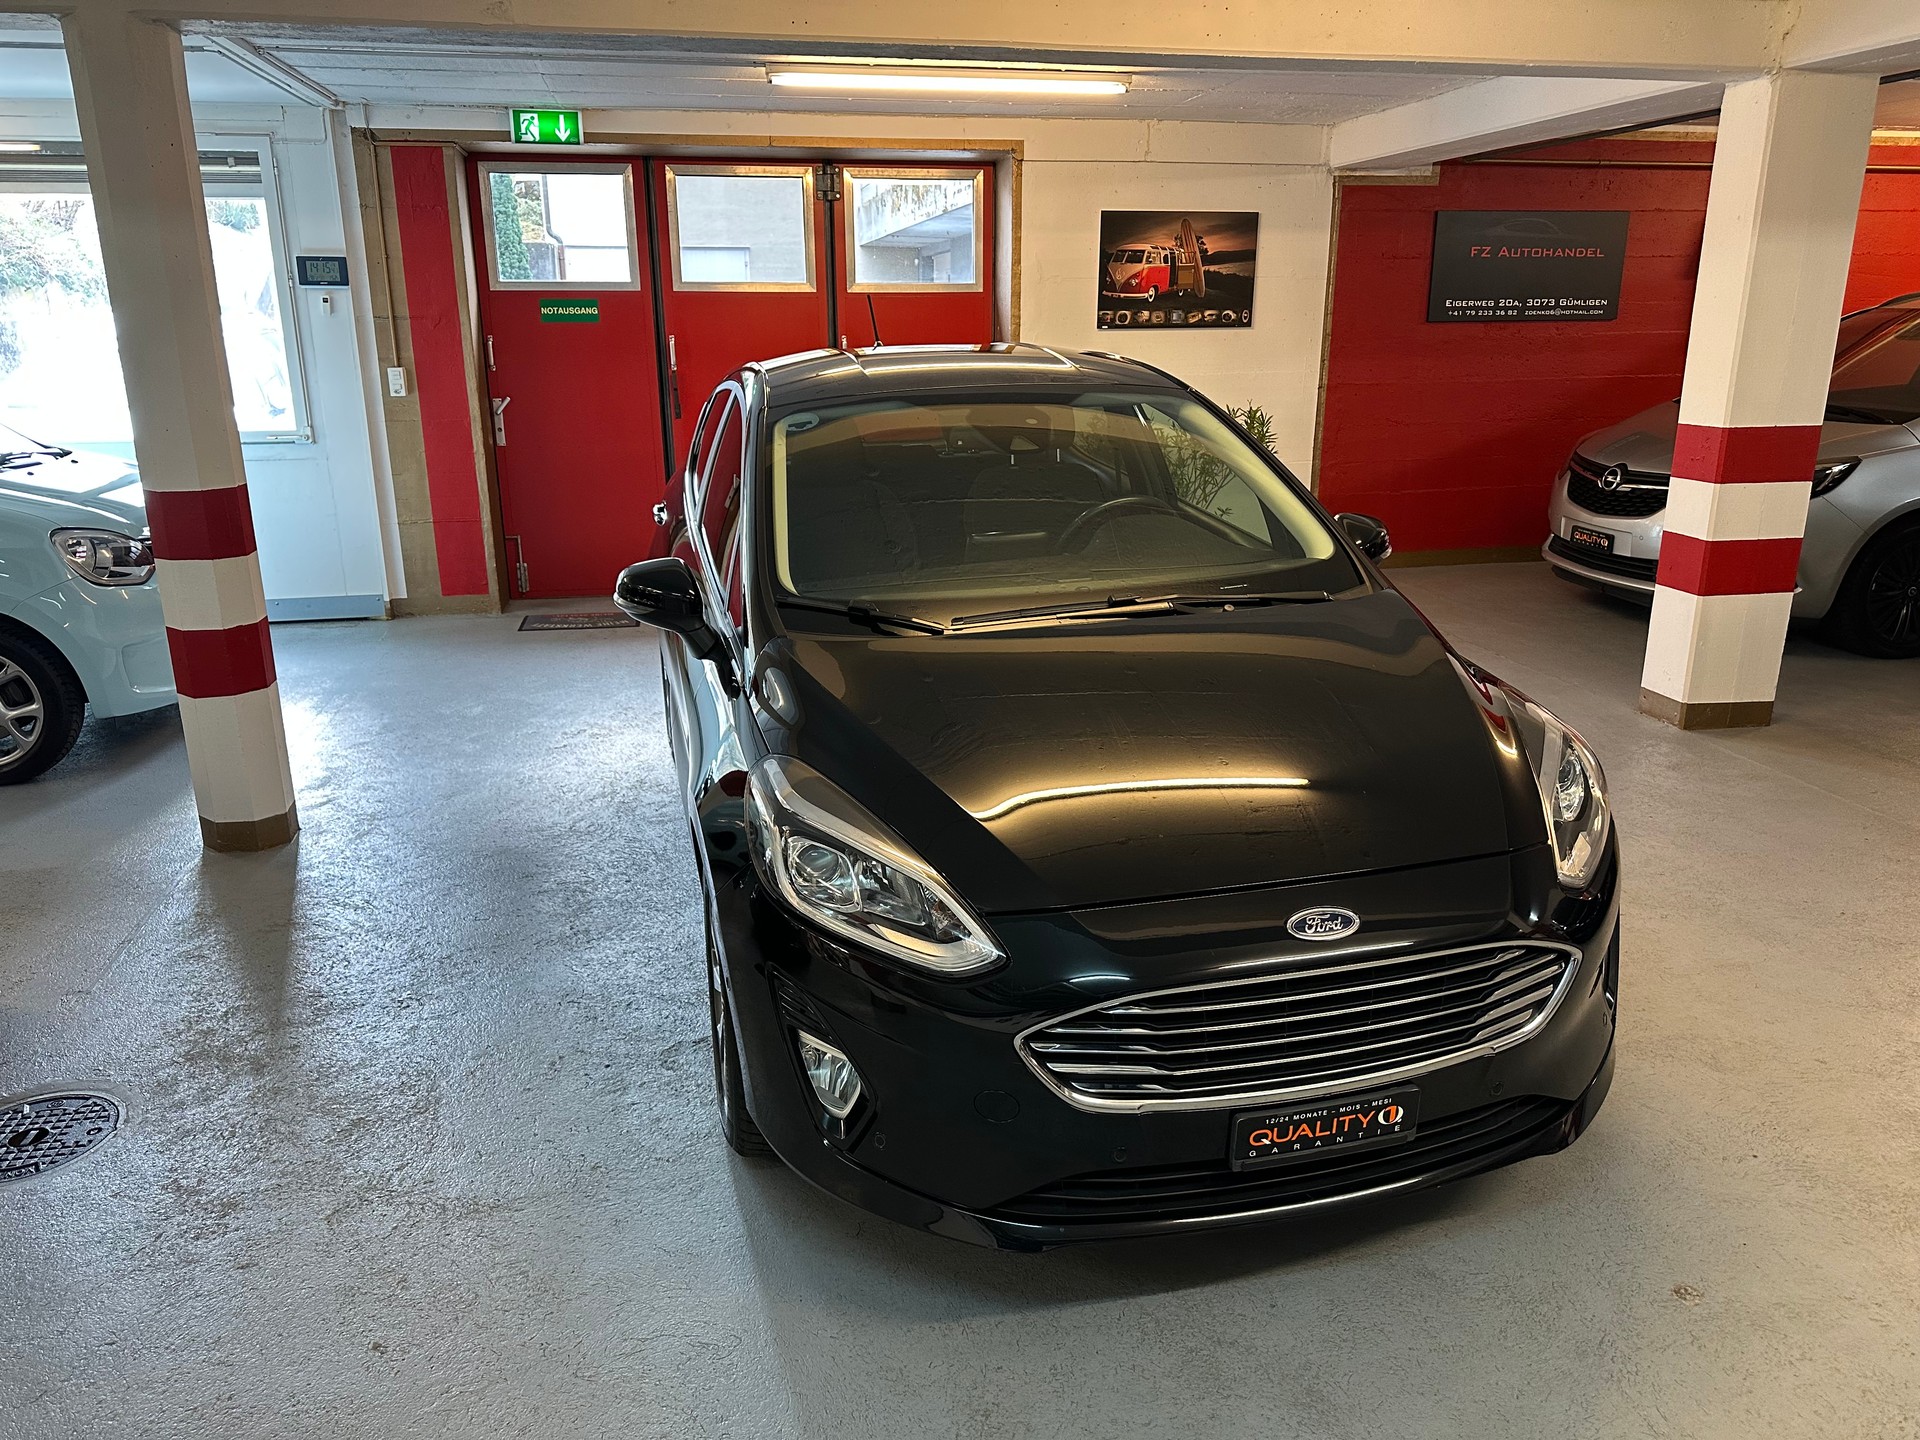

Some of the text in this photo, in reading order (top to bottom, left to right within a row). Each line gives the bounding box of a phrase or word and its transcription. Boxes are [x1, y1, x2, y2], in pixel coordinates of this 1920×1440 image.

[1470, 246, 1492, 257] FZ
[540, 306, 599, 315] NOTAUSGANG
[1526, 298, 1556, 306] 3073
[1573, 531, 1601, 544] QUALITY
[1304, 913, 1344, 934] Ford
[1265, 1116, 1289, 1125] 12/24
[1292, 1109, 1328, 1121] MONATE
[1339, 1103, 1361, 1113] MOIS
[1371, 1097, 1392, 1107] MESI
[1249, 1110, 1376, 1147] QUALITY
[1248, 1124, 1401, 1157] GARANTIE
